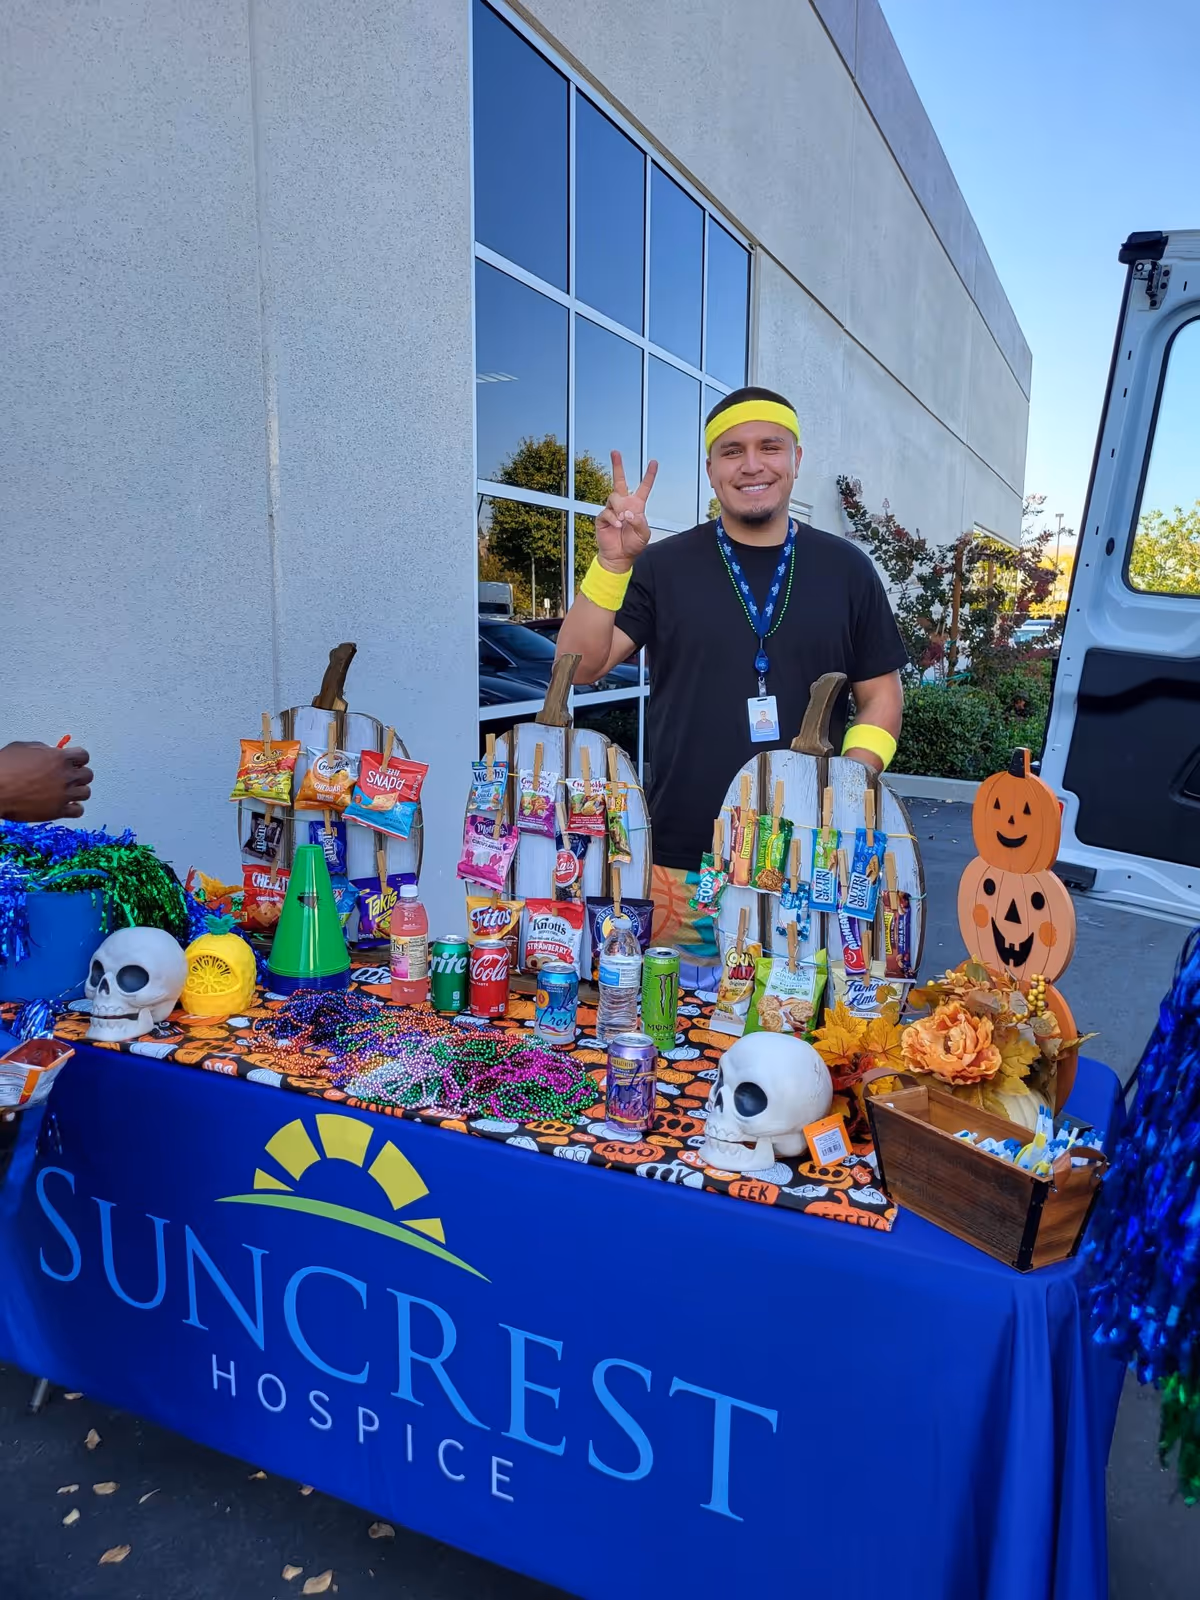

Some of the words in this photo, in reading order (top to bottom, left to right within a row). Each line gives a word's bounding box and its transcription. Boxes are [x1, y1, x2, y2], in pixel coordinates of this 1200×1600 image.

[473, 769, 504, 782] Weh's
[815, 870, 823, 899] NUTRI
[822, 871, 830, 901] GRAIN
[848, 875, 860, 906] NUTRI
[857, 878, 868, 907] GRAIN
[365, 890, 398, 920] Takis
[470, 906, 512, 932] Fritos
[533, 917, 567, 935] Knott's
[527, 942, 568, 955] STRAWBERRY
[431, 952, 467, 974] rite
[729, 965, 755, 980] NUT
[603, 1141, 655, 1157] BOO
[737, 1183, 768, 1201] EEK
[37, 1167, 778, 1521] SUNCREST
[212, 1353, 514, 1502] HOSPICE
